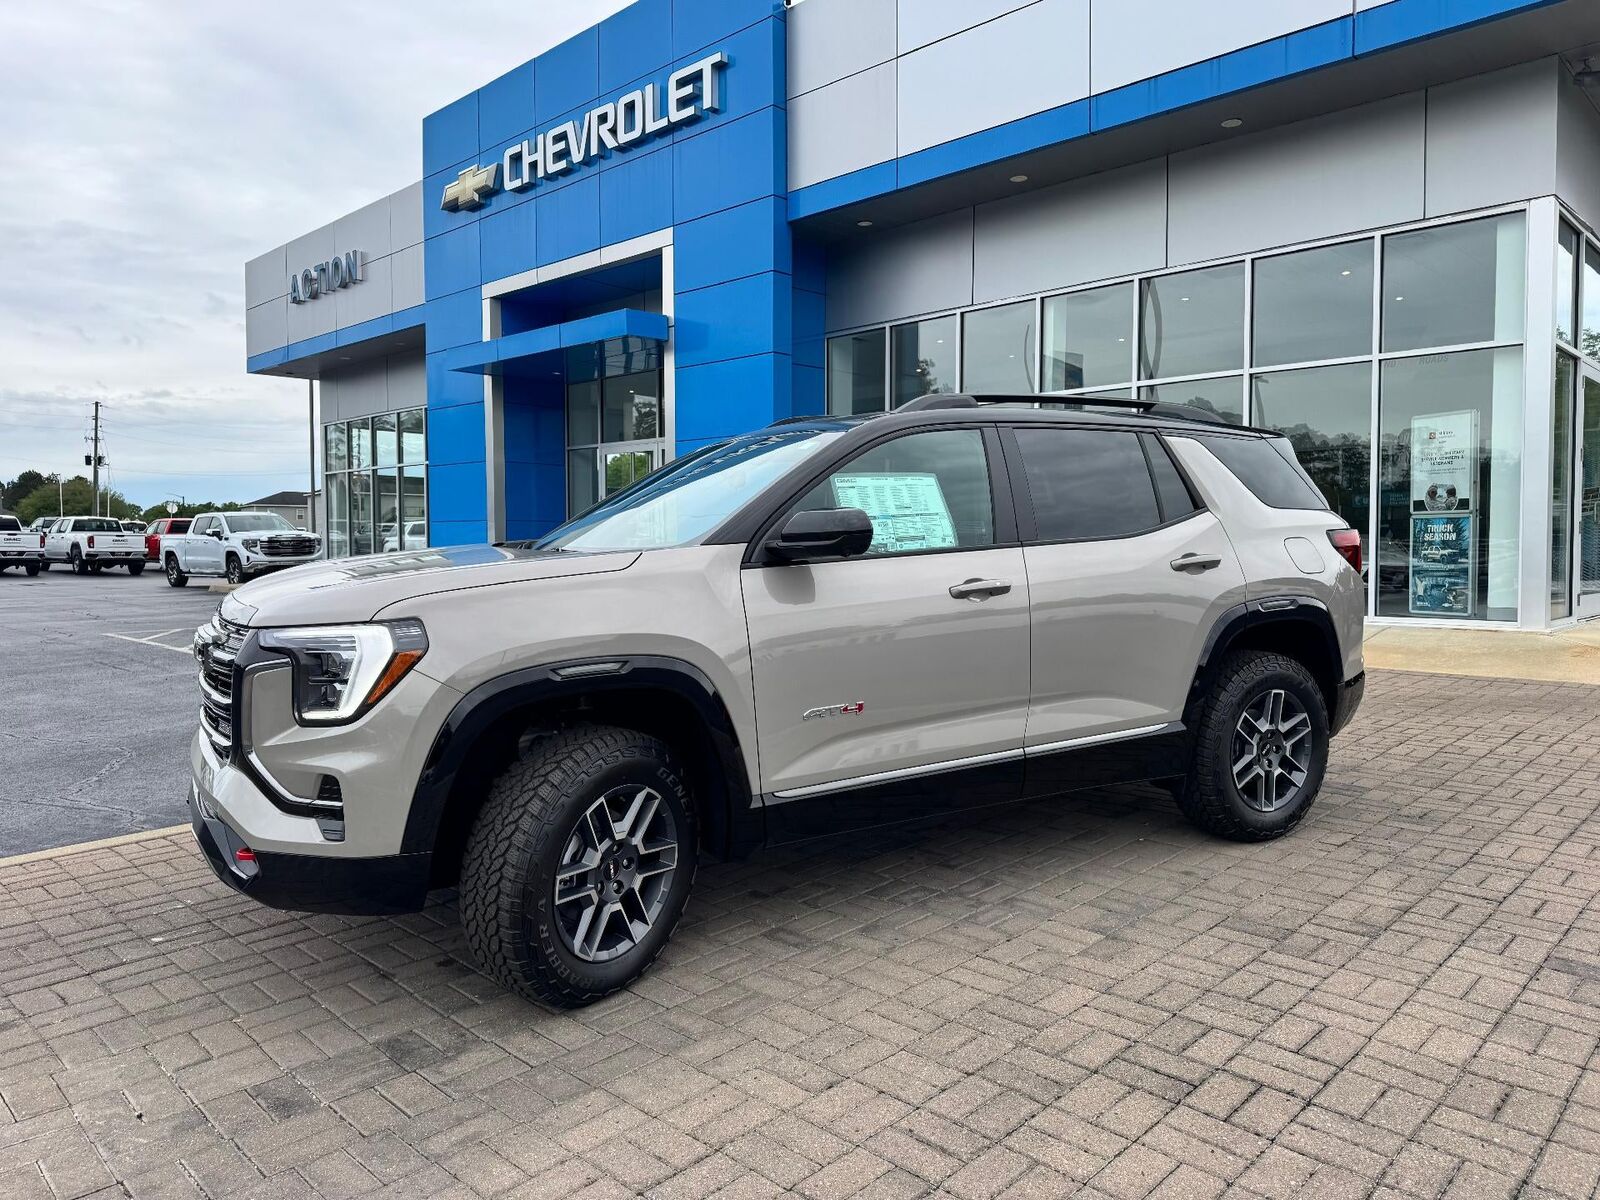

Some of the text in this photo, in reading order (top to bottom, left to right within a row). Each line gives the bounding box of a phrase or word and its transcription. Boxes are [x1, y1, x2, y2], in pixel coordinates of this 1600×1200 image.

[503, 51, 725, 191] CHEVROLET
[290, 249, 362, 304] ACTION
[1424, 532, 1457, 541] SEASON
[1427, 523, 1454, 533] TRUCK
[538, 921, 602, 990] RABBER
